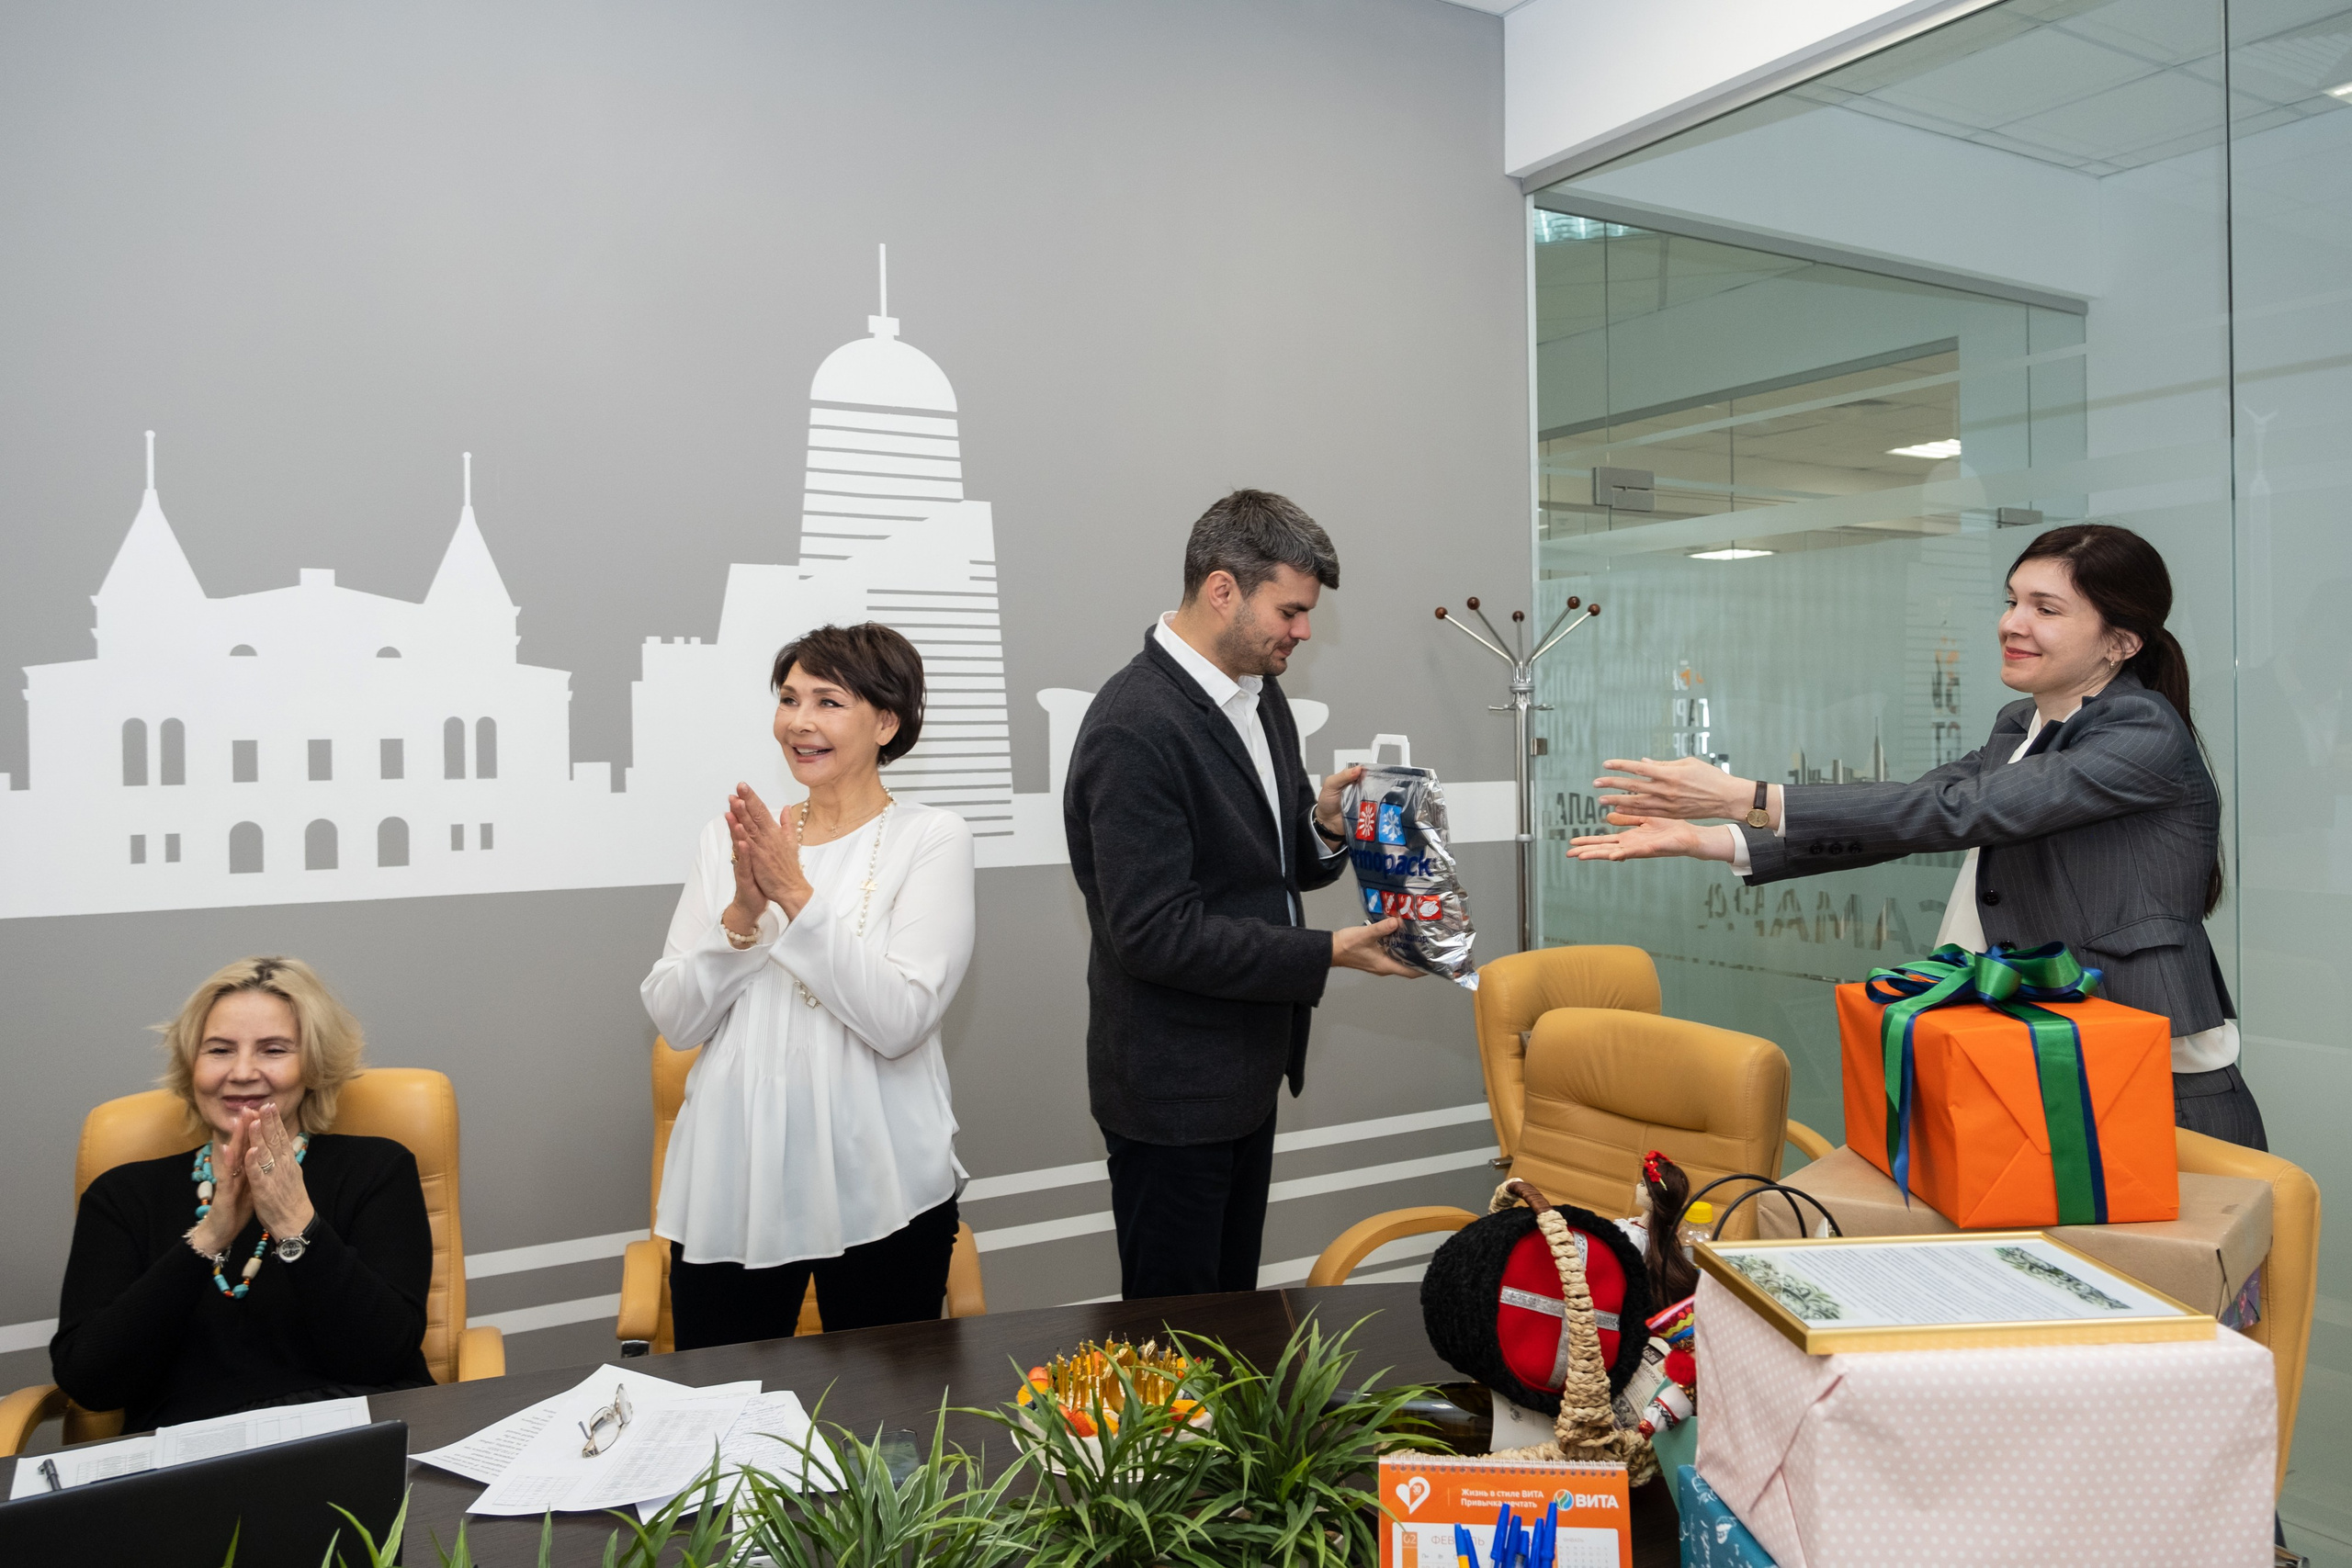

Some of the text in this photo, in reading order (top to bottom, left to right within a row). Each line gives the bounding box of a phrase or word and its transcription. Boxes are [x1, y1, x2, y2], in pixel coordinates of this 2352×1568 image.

[1461, 1488, 1488, 1497] Жизнь
[1521, 1490, 1544, 1498] ВИТА
[1461, 1498, 1502, 1507] Привычка
[1576, 1494, 1619, 1508] ВИТА
[1430, 1535, 1486, 1546] ФЕВЛЬ
